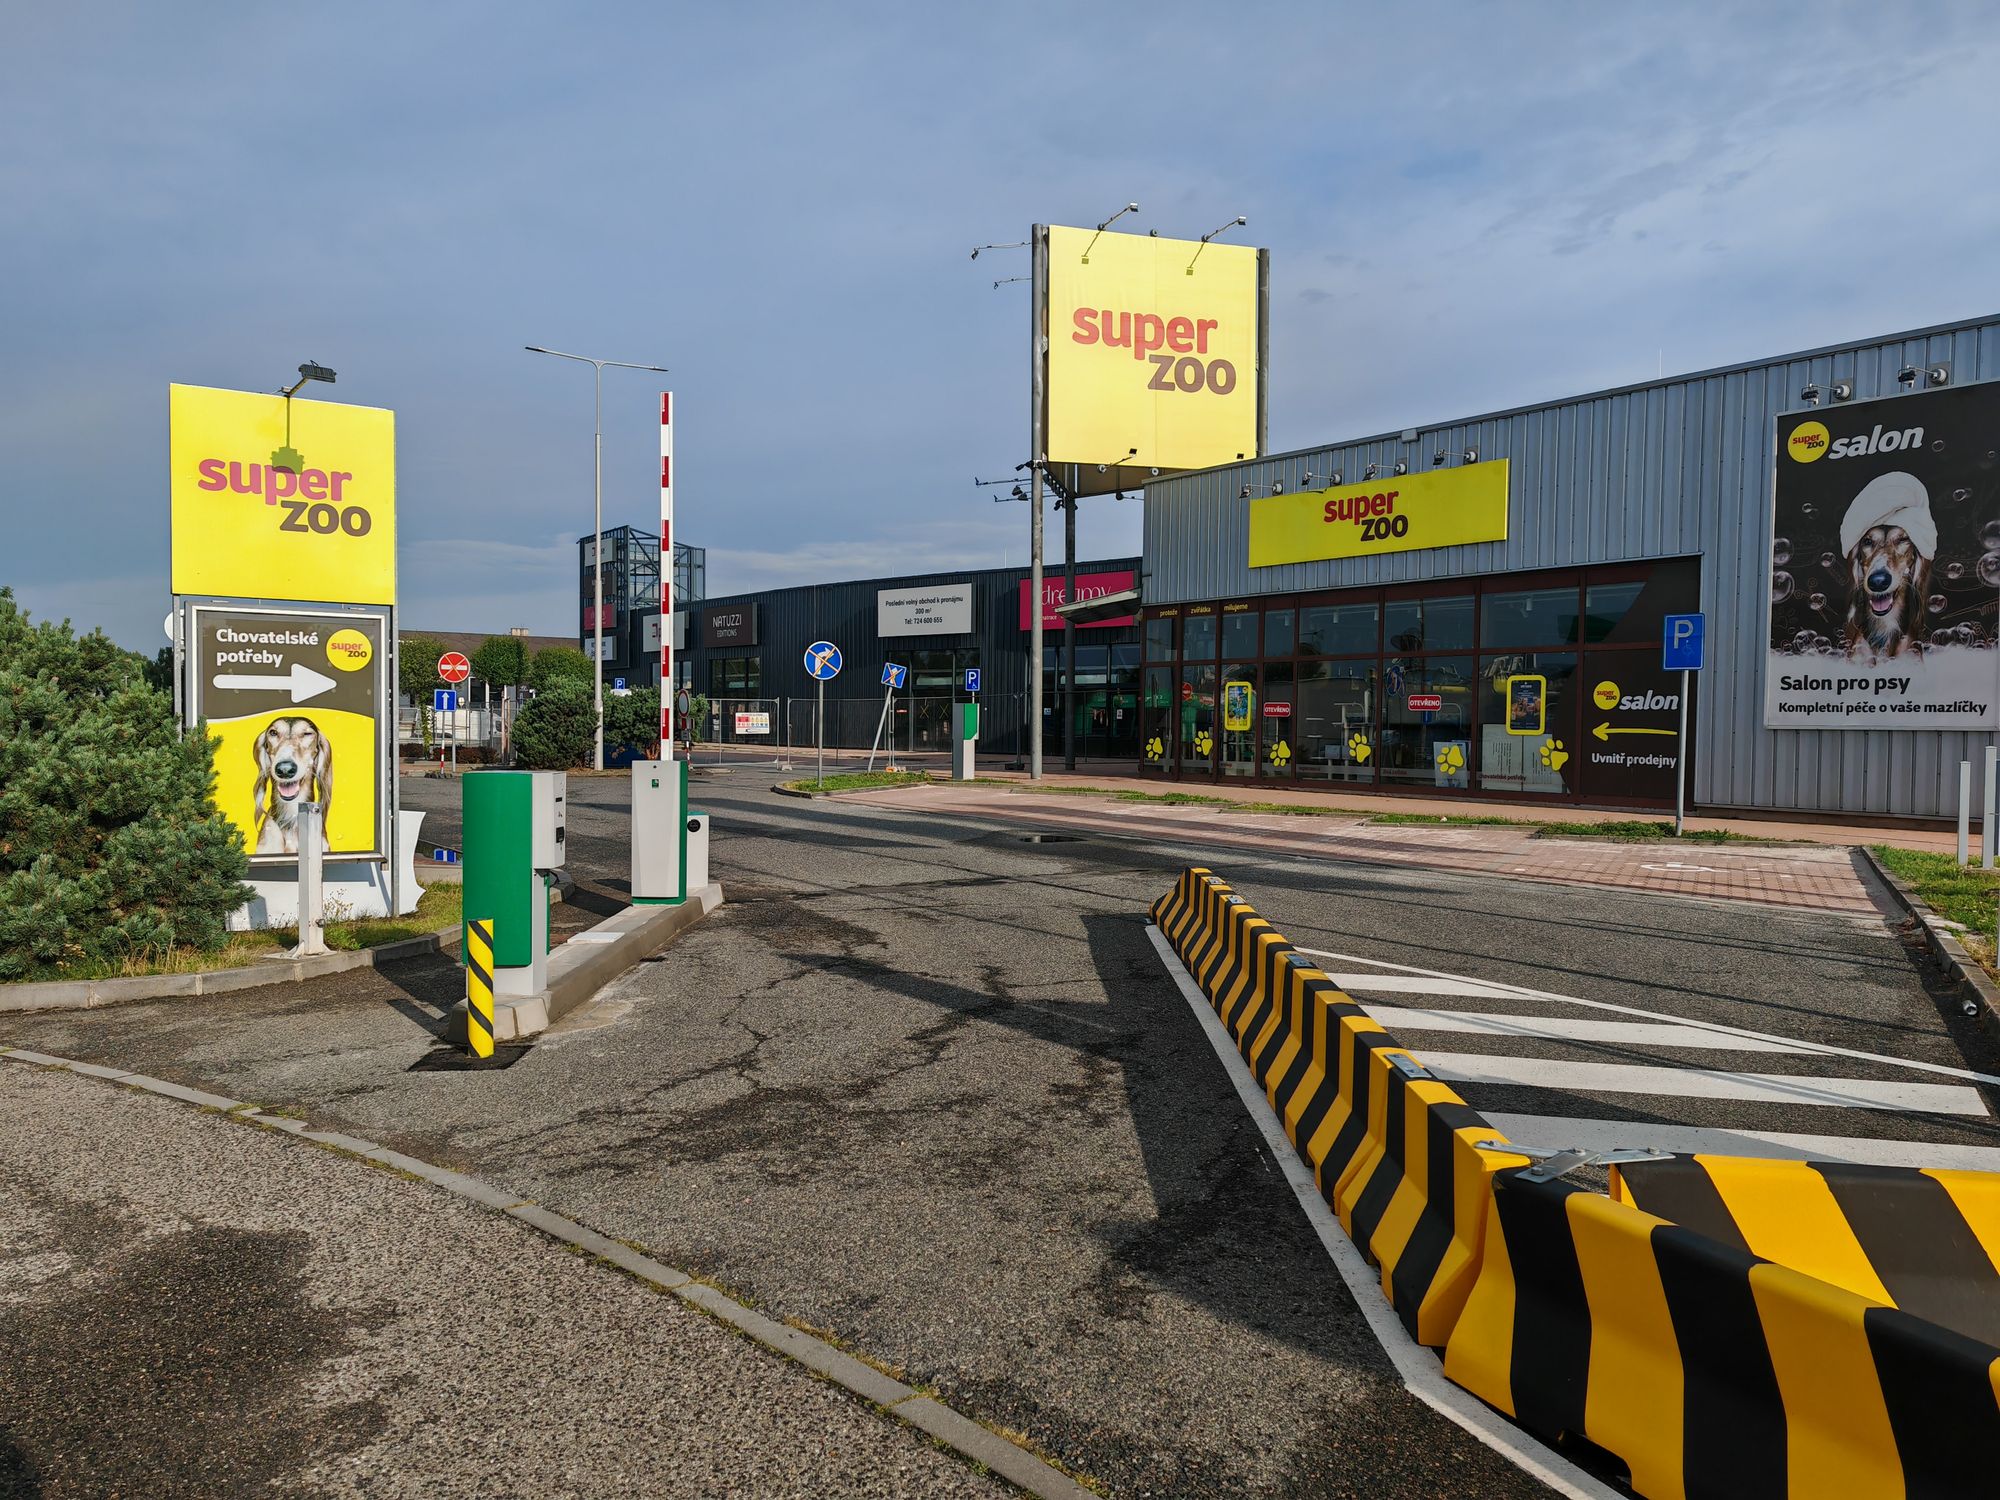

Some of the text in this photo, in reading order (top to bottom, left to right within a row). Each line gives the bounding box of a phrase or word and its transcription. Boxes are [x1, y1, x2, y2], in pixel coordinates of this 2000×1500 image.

[1072, 307, 1218, 360] super
[1147, 354, 1237, 395] zoo
[1792, 424, 1924, 459] super salon
[1807, 440, 1824, 449] zoo
[198, 458, 352, 505] super
[1323, 490, 1399, 525] super
[279, 500, 371, 536] zoo
[1360, 514, 1409, 541] zoo
[885, 599, 905, 607] Poslední
[906, 598, 918, 606] volný
[940, 595, 963, 604] pronájmu
[712, 613, 742, 628] NATUZZI
[216, 628, 319, 646] Chovatelské
[716, 628, 737, 638] EDITIONS
[1673, 619, 1694, 649] P
[331, 642, 363, 652] super
[347, 650, 367, 658] zoo
[216, 648, 284, 668] potřeby
[968, 671, 977, 685] P
[1780, 675, 1911, 695] Salon pro psy
[1409, 697, 1440, 707] OTEVŘENO
[1619, 689, 1679, 710] salon
[1778, 701, 1988, 716] Kompletní péče o vaše mazlíčky
[1264, 705, 1290, 714] OTEVŘENO
[1591, 752, 1677, 769] Uvnitř prodejny
